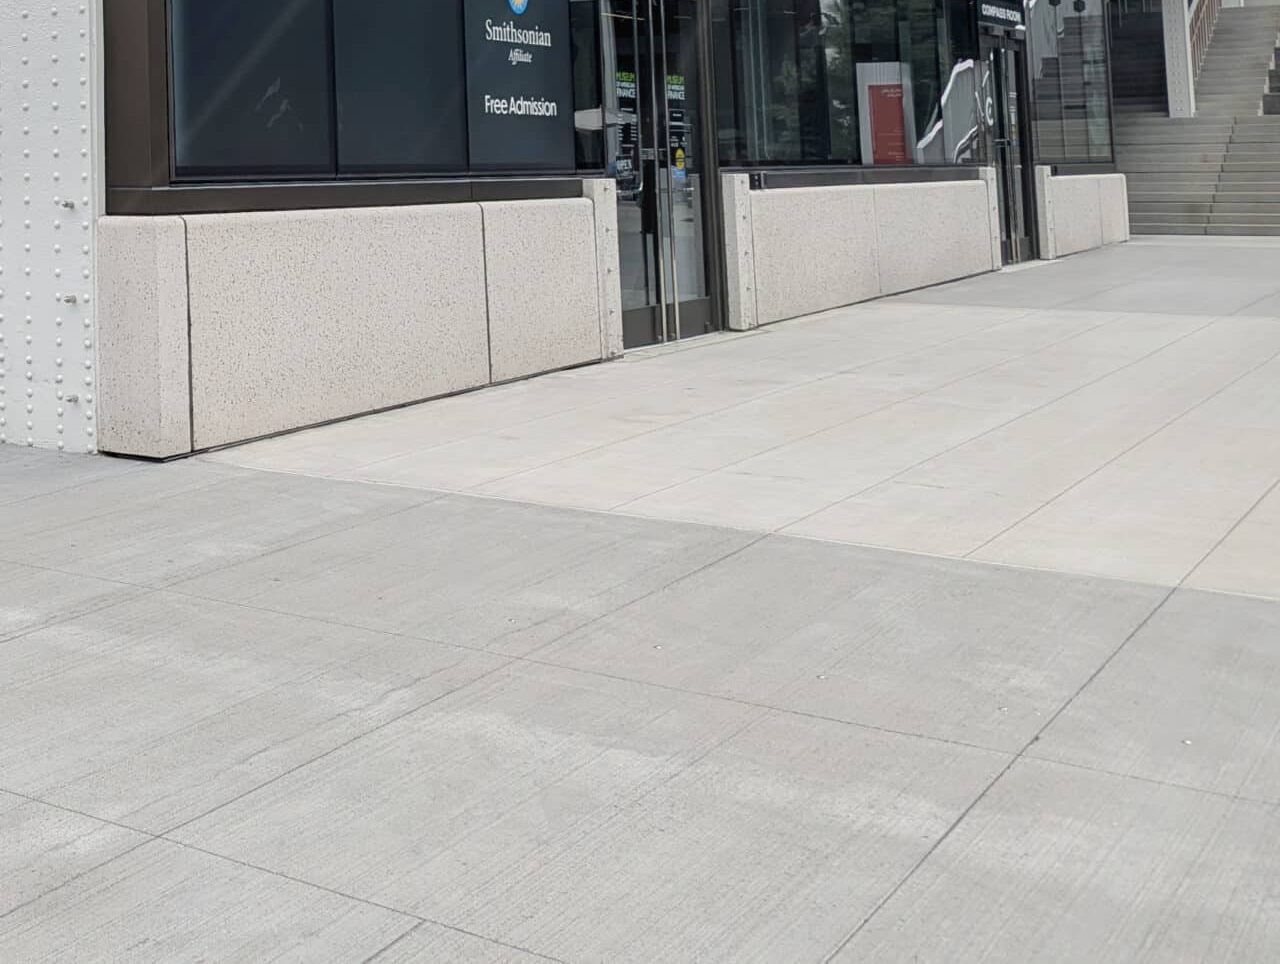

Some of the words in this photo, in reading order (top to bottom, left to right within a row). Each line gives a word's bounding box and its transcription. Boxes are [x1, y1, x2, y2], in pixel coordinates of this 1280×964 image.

[485, 19, 551, 47] Smithsonian
[484, 95, 508, 115] Free
[509, 96, 557, 116] Admission
